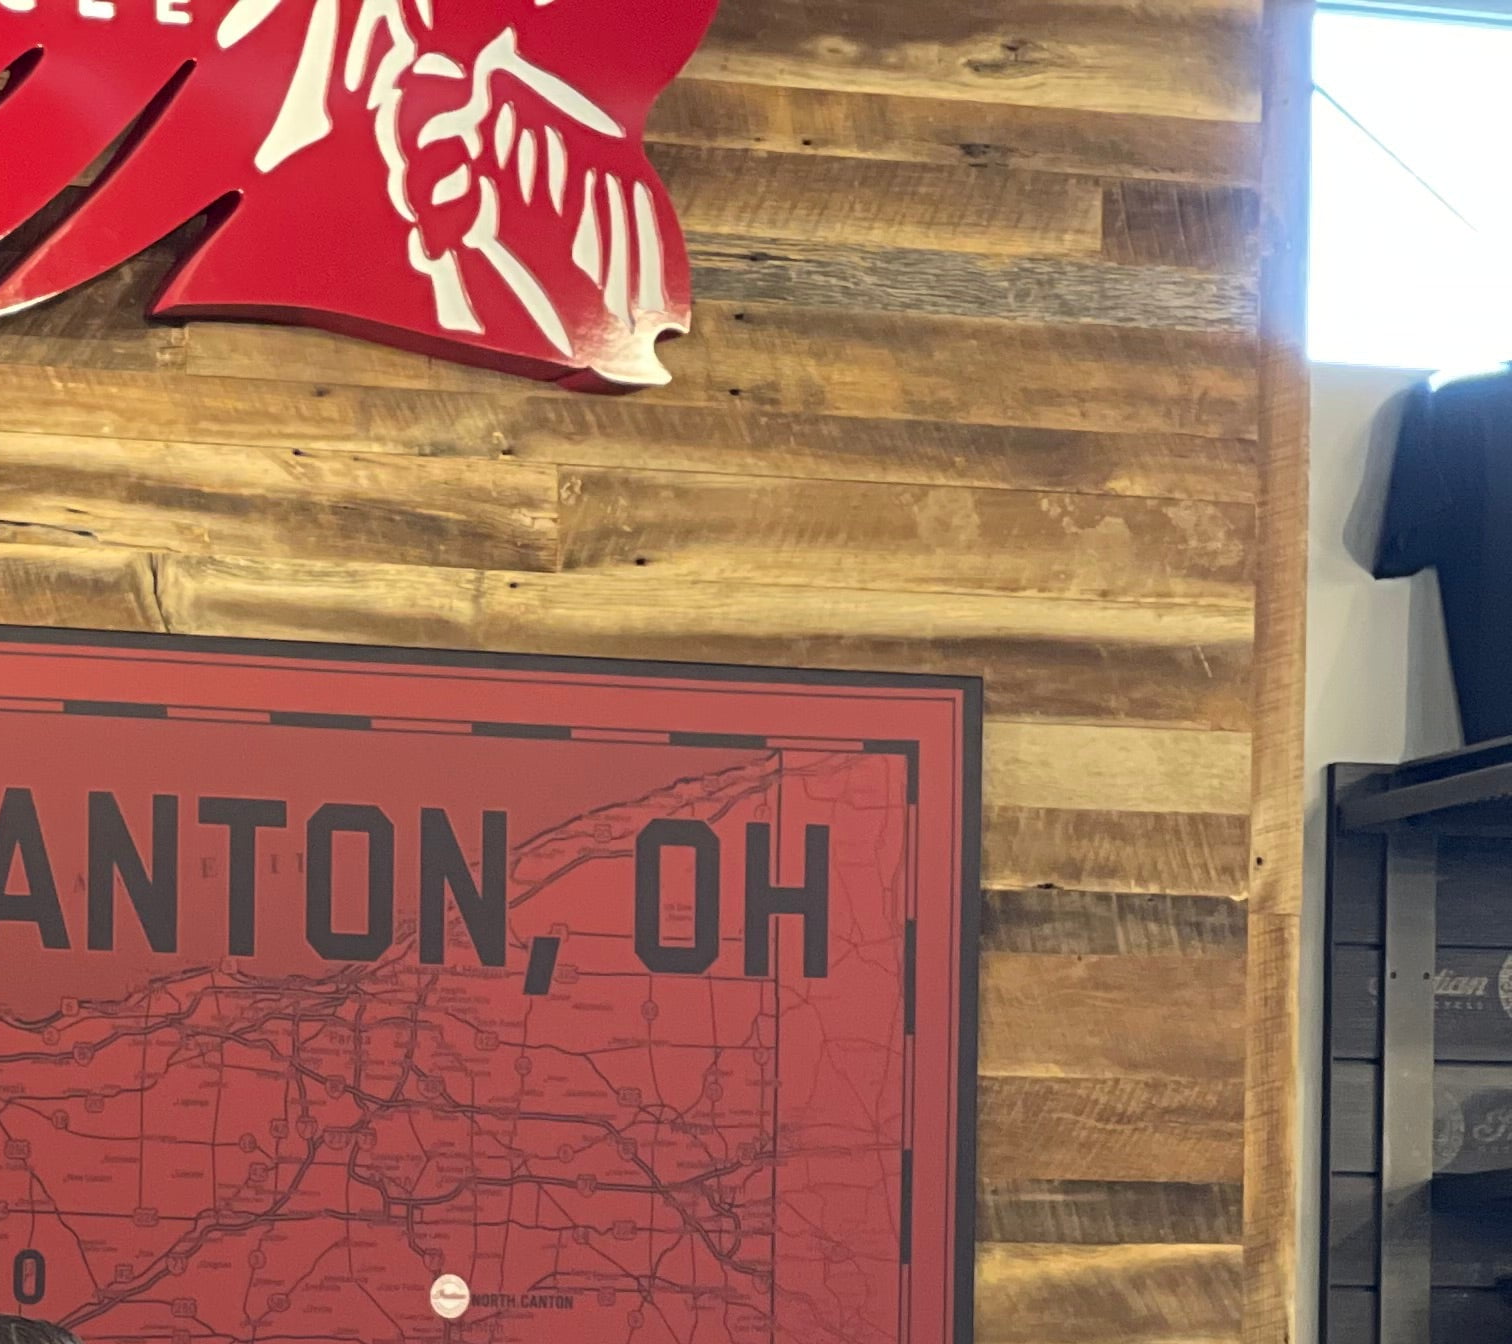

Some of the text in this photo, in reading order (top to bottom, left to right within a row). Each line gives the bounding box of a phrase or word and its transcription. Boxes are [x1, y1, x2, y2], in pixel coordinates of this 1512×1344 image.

[634, 818, 830, 980] OH
[471, 1293, 516, 1308] NORTH
[521, 1295, 574, 1310] CANTON
